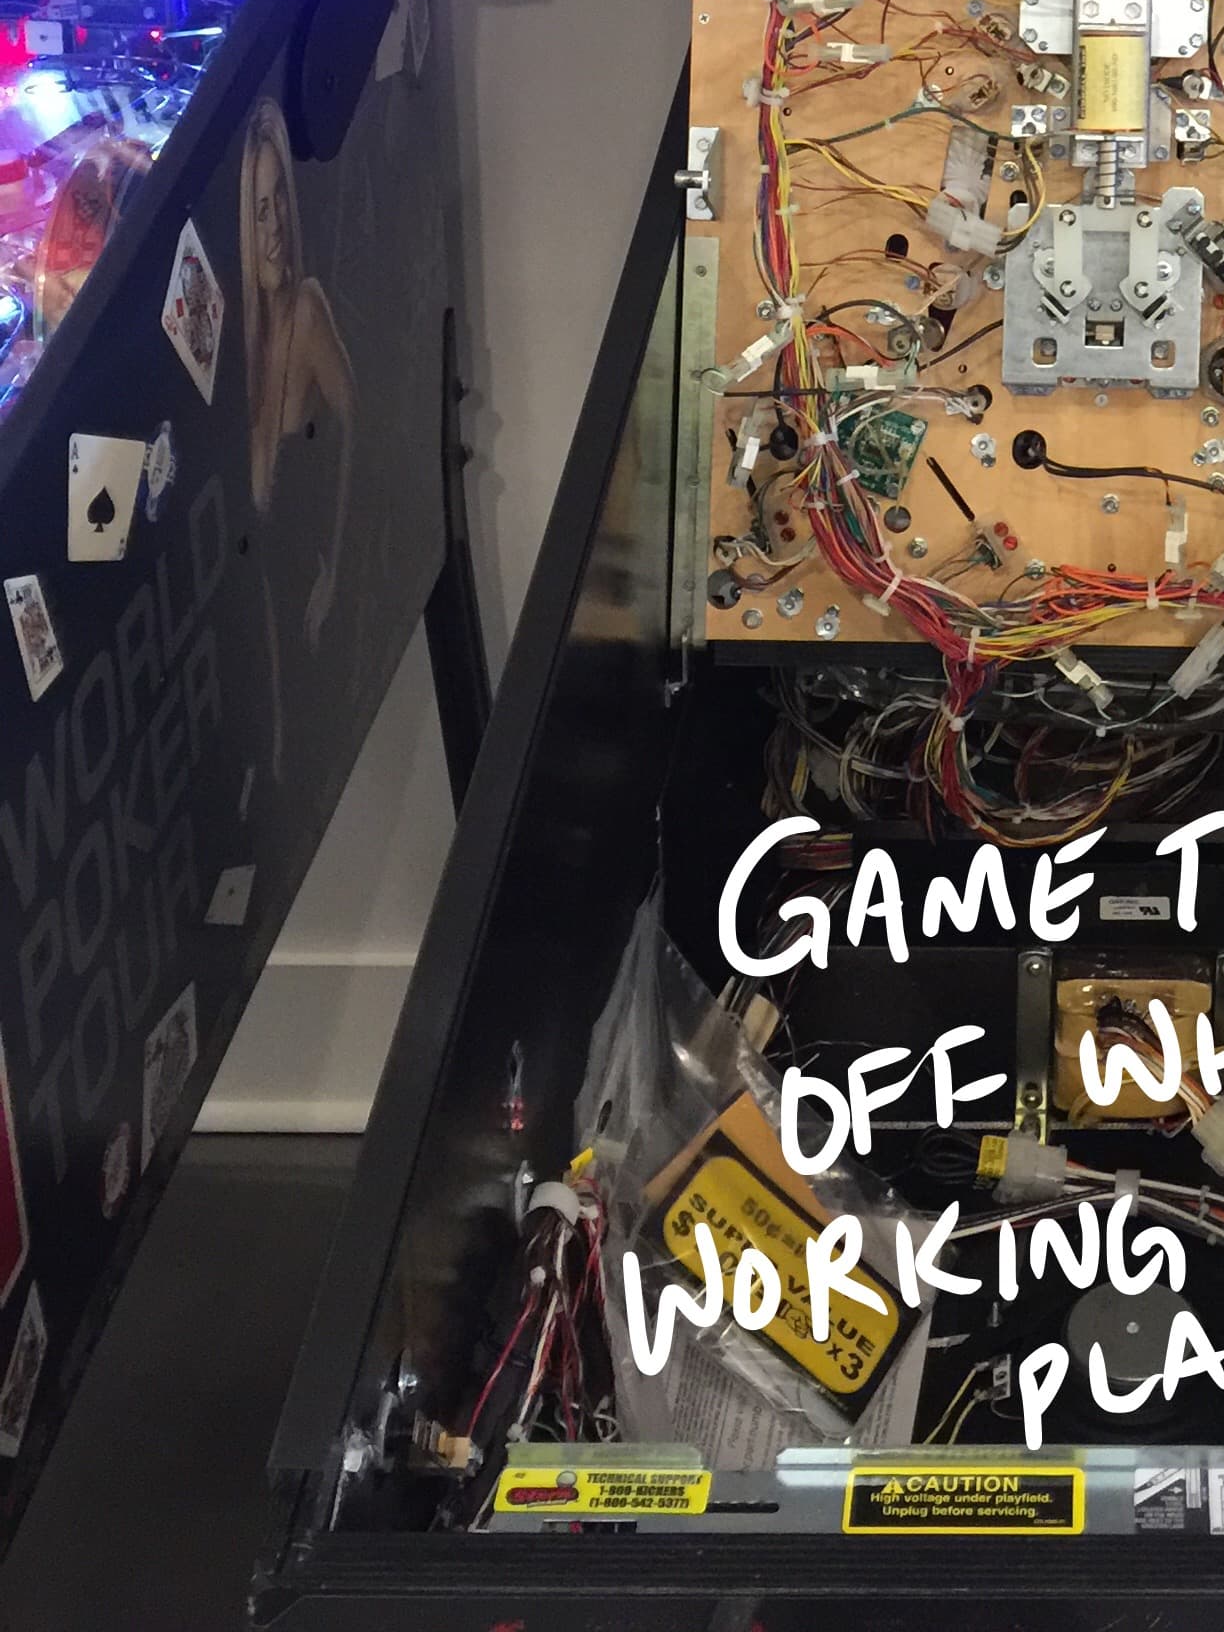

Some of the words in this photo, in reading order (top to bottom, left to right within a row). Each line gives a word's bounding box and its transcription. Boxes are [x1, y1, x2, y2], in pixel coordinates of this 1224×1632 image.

[906, 1475, 1020, 1493] CAUTION
[870, 1492, 900, 1504] High
[904, 1493, 951, 1505] voltage
[954, 1492, 992, 1504] under
[995, 1492, 1053, 1505] playfield.
[882, 1505, 928, 1518] Unplug
[931, 1505, 974, 1517] before
[977, 1505, 1038, 1519] servicing.
